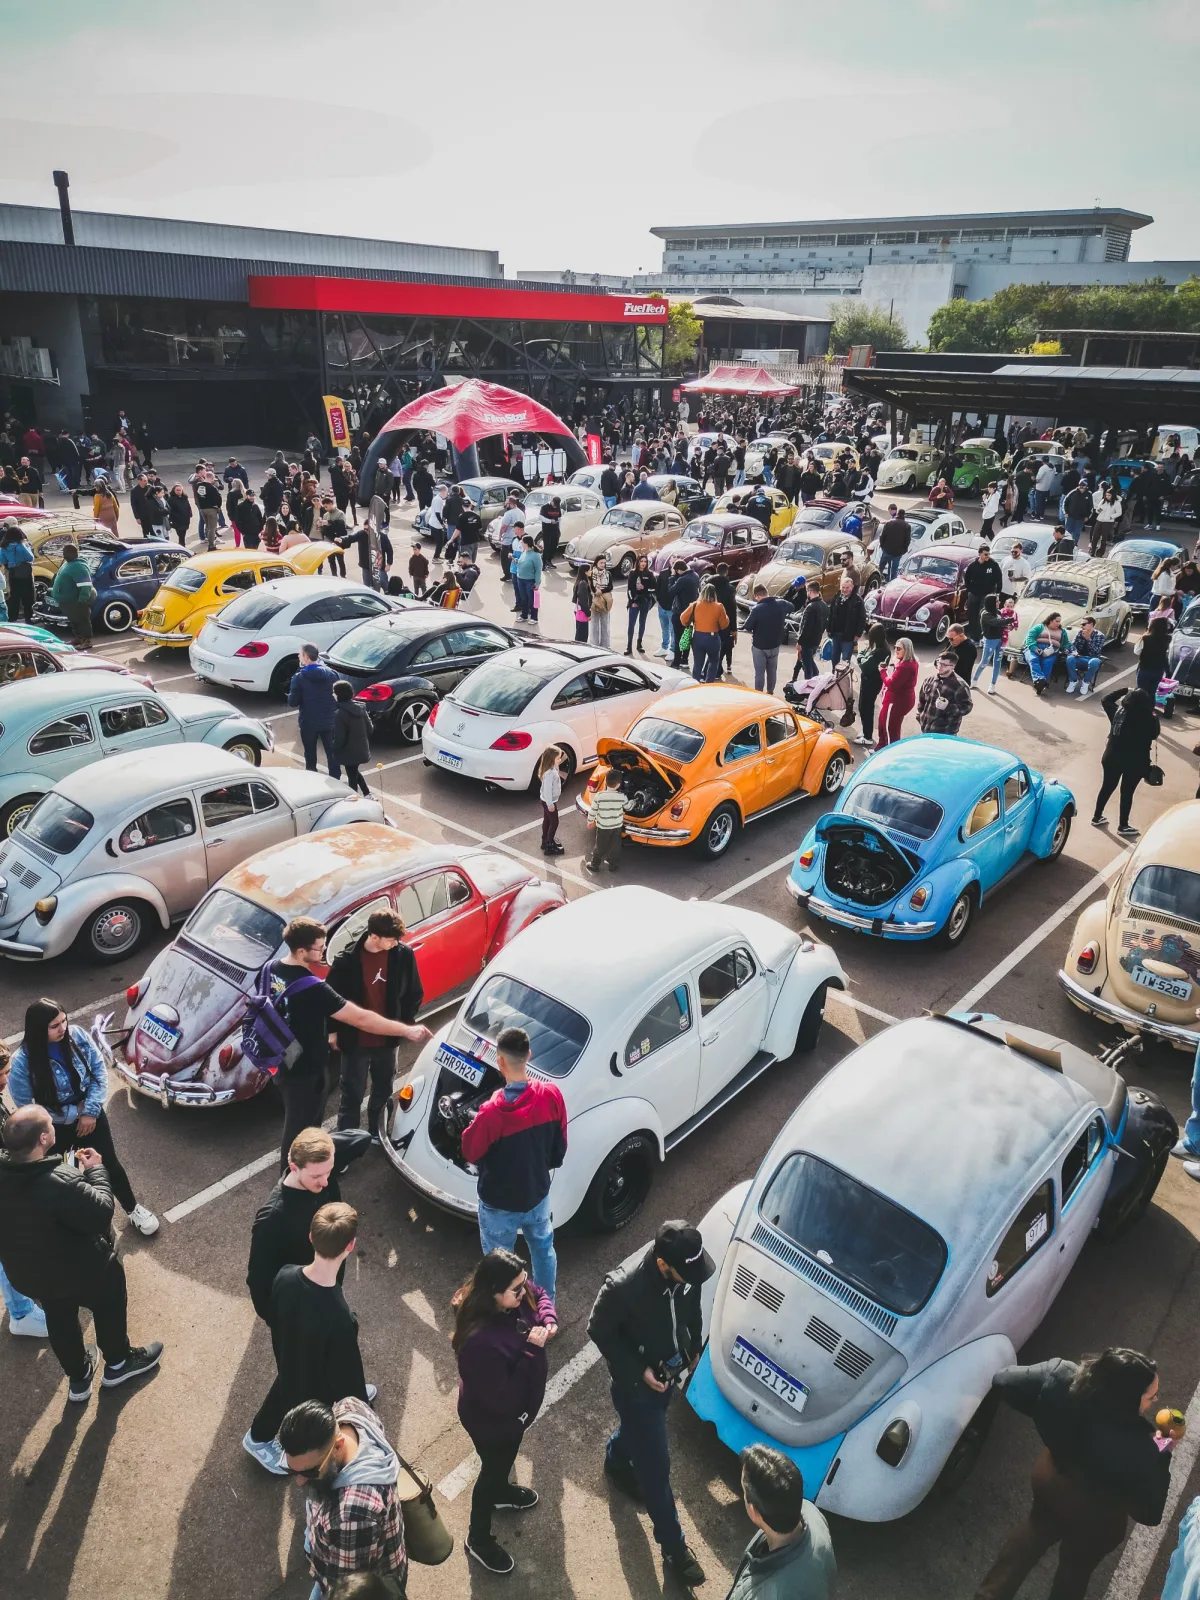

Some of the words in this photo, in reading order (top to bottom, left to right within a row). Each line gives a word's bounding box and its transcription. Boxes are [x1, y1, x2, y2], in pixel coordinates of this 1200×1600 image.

[624, 302, 666, 315] FuelTech
[484, 411, 526, 423] FilmStar
[438, 1051, 477, 1082] IHR9H26
